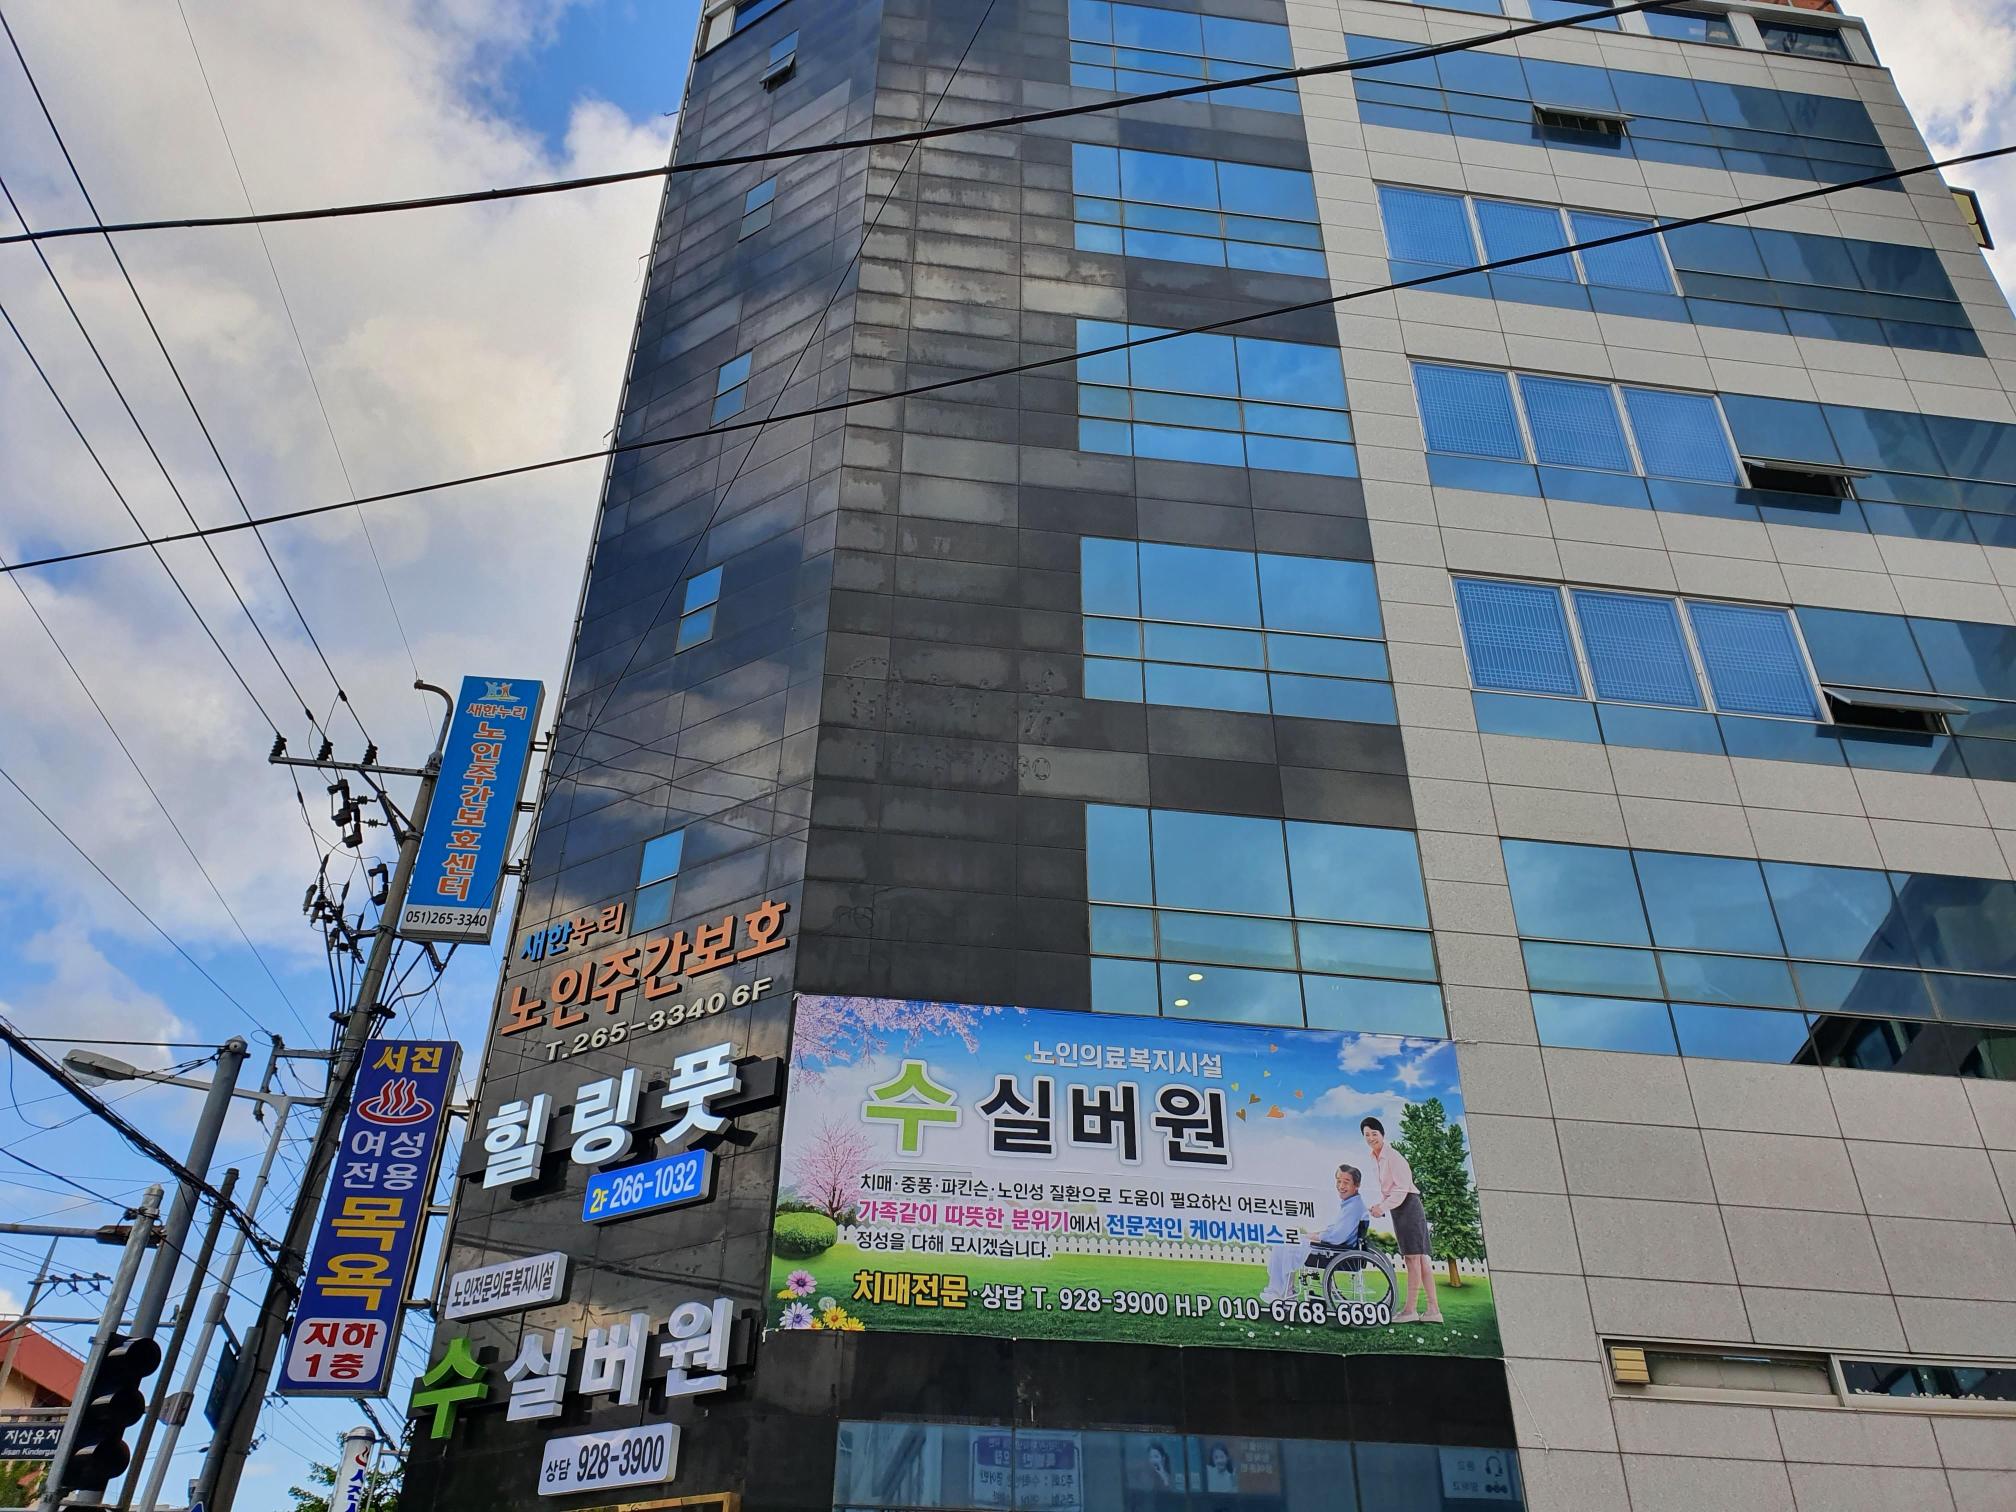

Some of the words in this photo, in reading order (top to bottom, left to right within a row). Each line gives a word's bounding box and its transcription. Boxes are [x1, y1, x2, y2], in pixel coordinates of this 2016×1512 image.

[466, 703, 528, 720] 새한누리
[436, 721, 507, 902] 노인주간보호센터
[405, 910, 488, 927] 051)265-3340
[521, 902, 628, 962] 새한누리
[501, 900, 790, 1036] 노인주간보호
[732, 977, 774, 1005] 6F
[372, 1046, 443, 1074] 서진
[1032, 1041, 1223, 1079] 노인의료복지시설
[483, 1042, 742, 1190] 힐링풋
[352, 1130, 426, 1159] 여성
[343, 1162, 418, 1190] 전용
[589, 1187, 610, 1214] 2F
[610, 1159, 698, 1209] 266-1032
[1050, 1184, 1113, 1203] 질환으로
[1118, 1188, 1165, 1208] 도움이
[1170, 1192, 1232, 1212] 필요하신
[1238, 1197, 1314, 1218] 어르신들께
[858, 1200, 937, 1225] 가족같이
[945, 1205, 1005, 1229] 따뜻한
[1011, 1209, 1100, 1233] 분위기에서
[1106, 1214, 1183, 1238] 전문적인
[1189, 1219, 1300, 1245] 케어서비스로
[316, 1196, 406, 1311] 목욕
[856, 1231, 906, 1251] 정성을
[912, 1234, 944, 1253] 다해
[950, 1236, 1051, 1258] 모시겠습니다.
[451, 1260, 555, 1308] 노인전문의료복지시설
[1031, 1286, 1053, 1311] T.
[1059, 1288, 1168, 1316] 928-3900
[1175, 1293, 1212, 1318] H.P
[1218, 1296, 1392, 1326] 010-6768-6690
[303, 1322, 379, 1349] 지하
[305, 1353, 364, 1380] 1층
[545, 1460, 571, 1483] 상담
[576, 1434, 665, 1483] 928-3900
